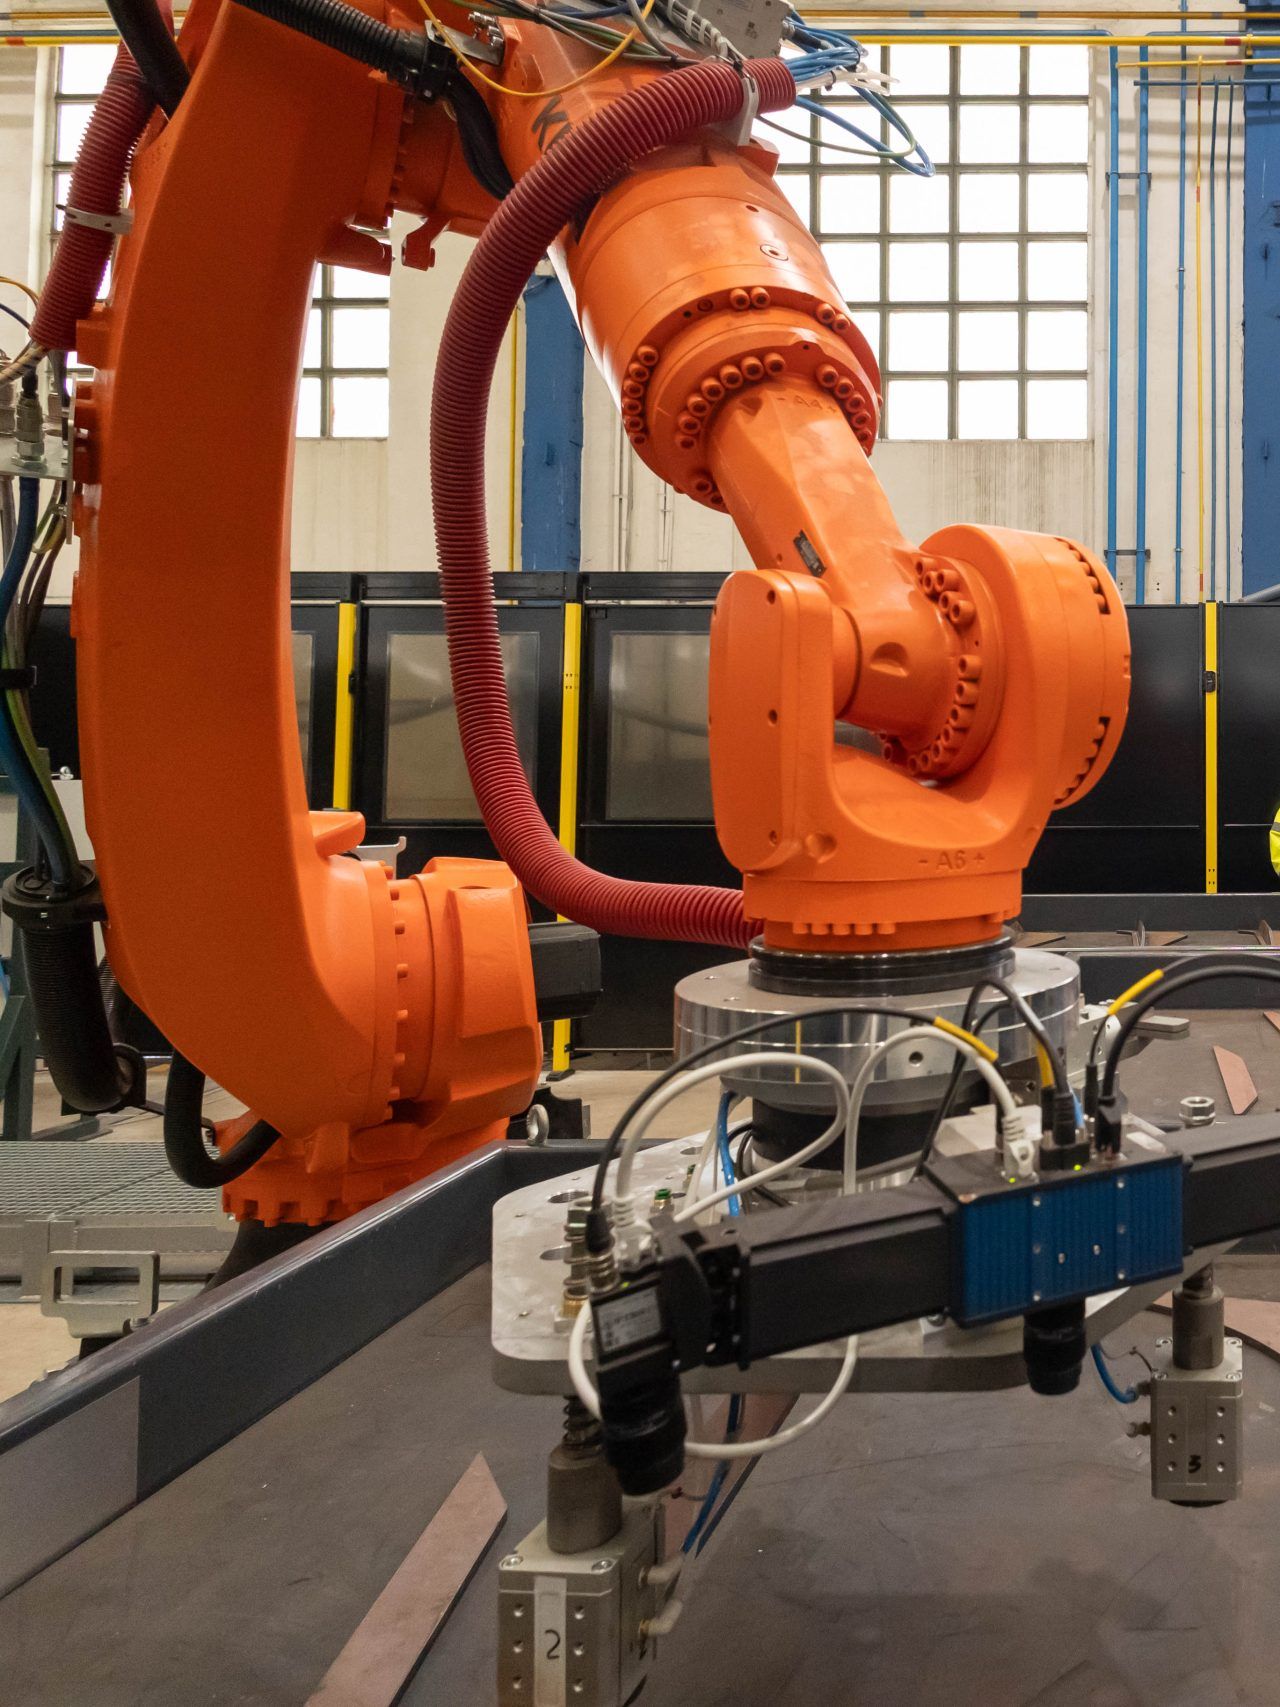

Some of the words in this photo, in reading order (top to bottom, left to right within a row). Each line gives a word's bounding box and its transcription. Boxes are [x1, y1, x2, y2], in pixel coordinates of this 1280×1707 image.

[935, 849, 966, 871] A6
[1188, 1454, 1201, 1474] 3
[544, 1629, 561, 1660] 2
